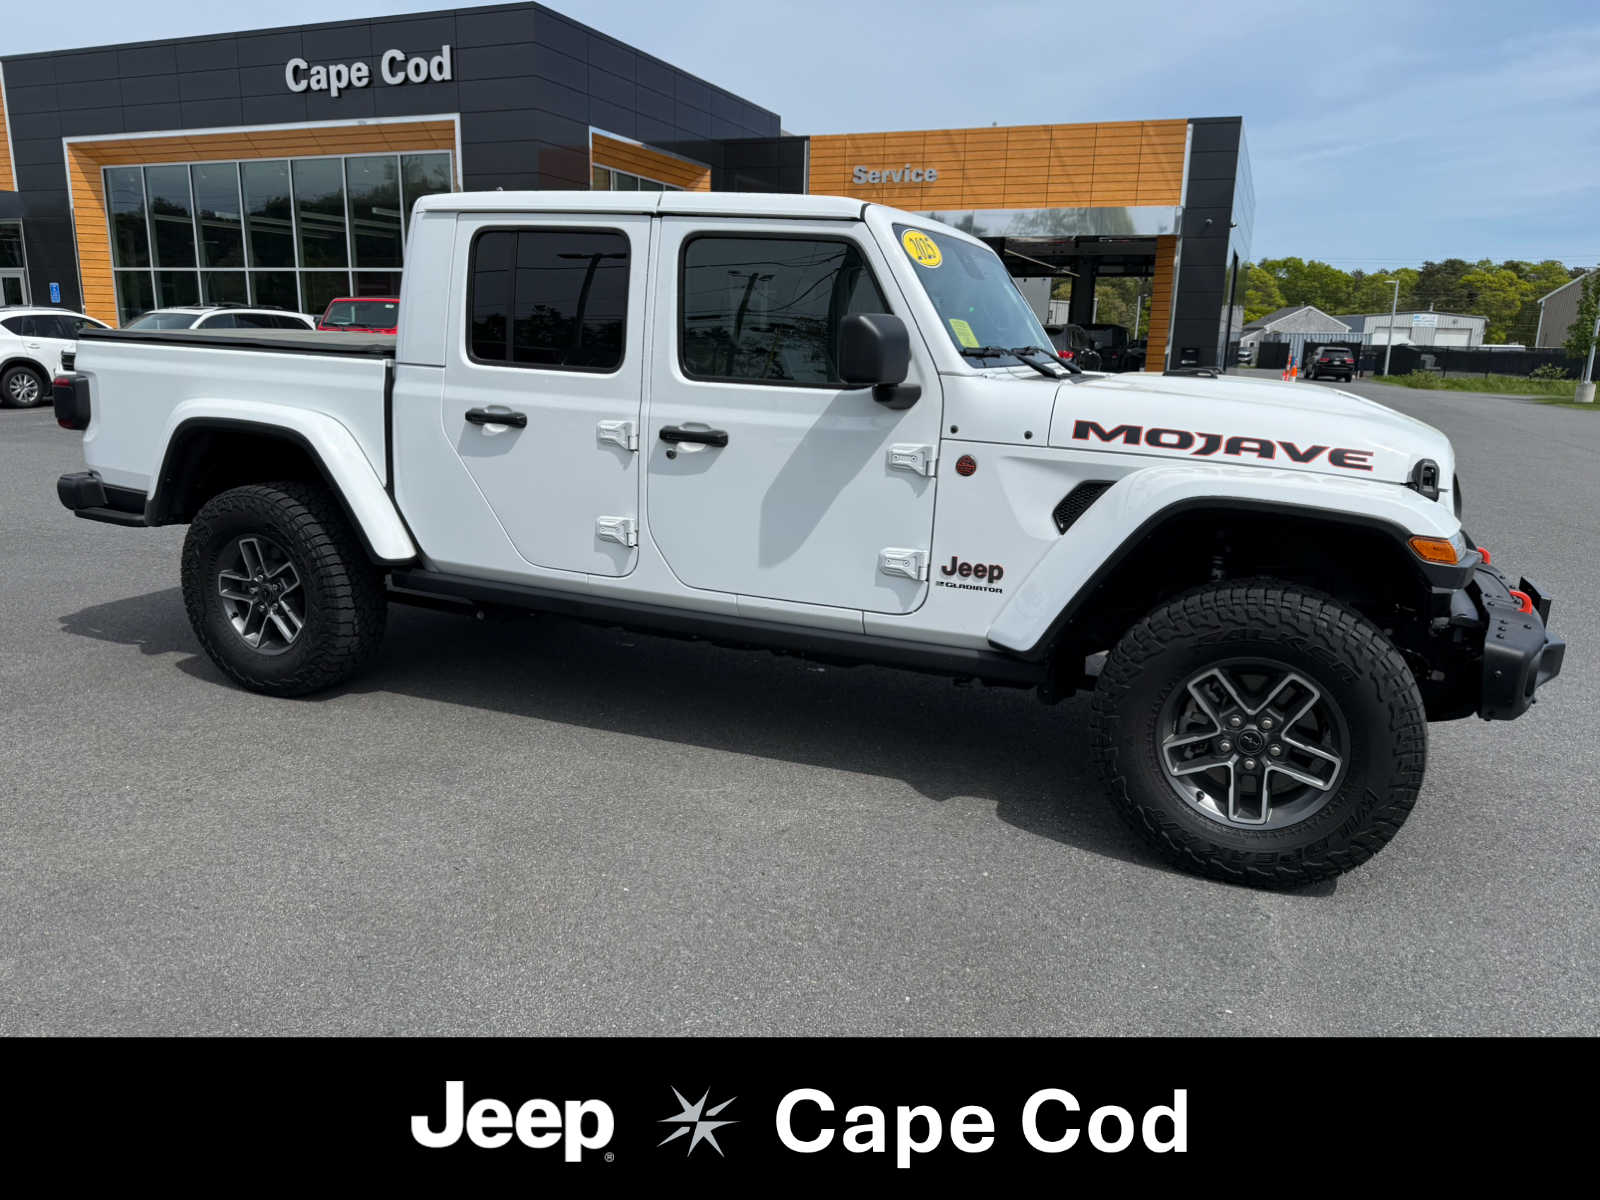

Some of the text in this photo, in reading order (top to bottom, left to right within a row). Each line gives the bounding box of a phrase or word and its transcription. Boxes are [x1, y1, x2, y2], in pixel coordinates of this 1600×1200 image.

[285, 45, 452, 97] Cape Cod
[852, 163, 938, 185] Service
[1072, 419, 1374, 472] MOJAVE
[941, 555, 1004, 584] Jeep
[945, 582, 1003, 594] GLADIATOR
